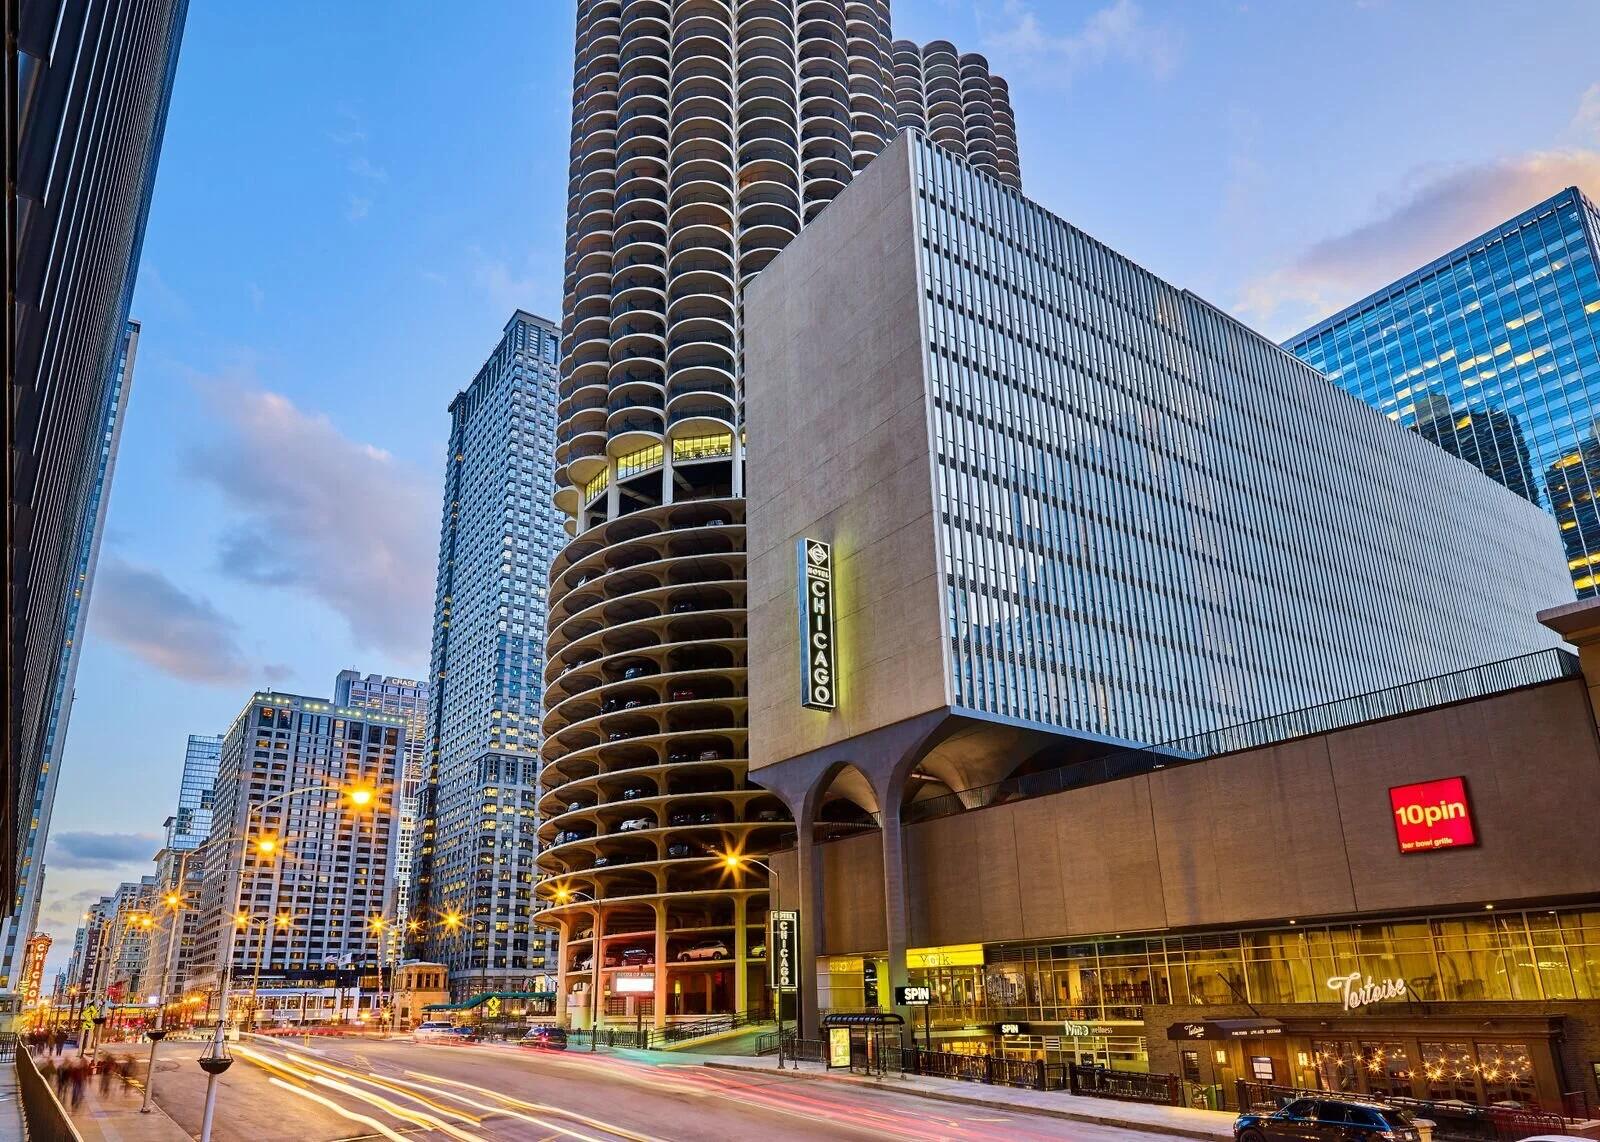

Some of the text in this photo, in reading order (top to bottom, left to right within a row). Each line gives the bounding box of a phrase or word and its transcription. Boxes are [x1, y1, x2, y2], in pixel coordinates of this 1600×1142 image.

[808, 567, 829, 578] HOTEL
[811, 581, 830, 703] CHICAGO
[392, 678, 417, 687] CHASE
[1395, 800, 1465, 827] 10pin
[1415, 839, 1432, 848] bowl
[1434, 837, 1453, 847] grille
[780, 922, 789, 986] CHICAGO
[27, 943, 45, 1006] CHICAGO
[1327, 972, 1406, 1011] Tortoise
